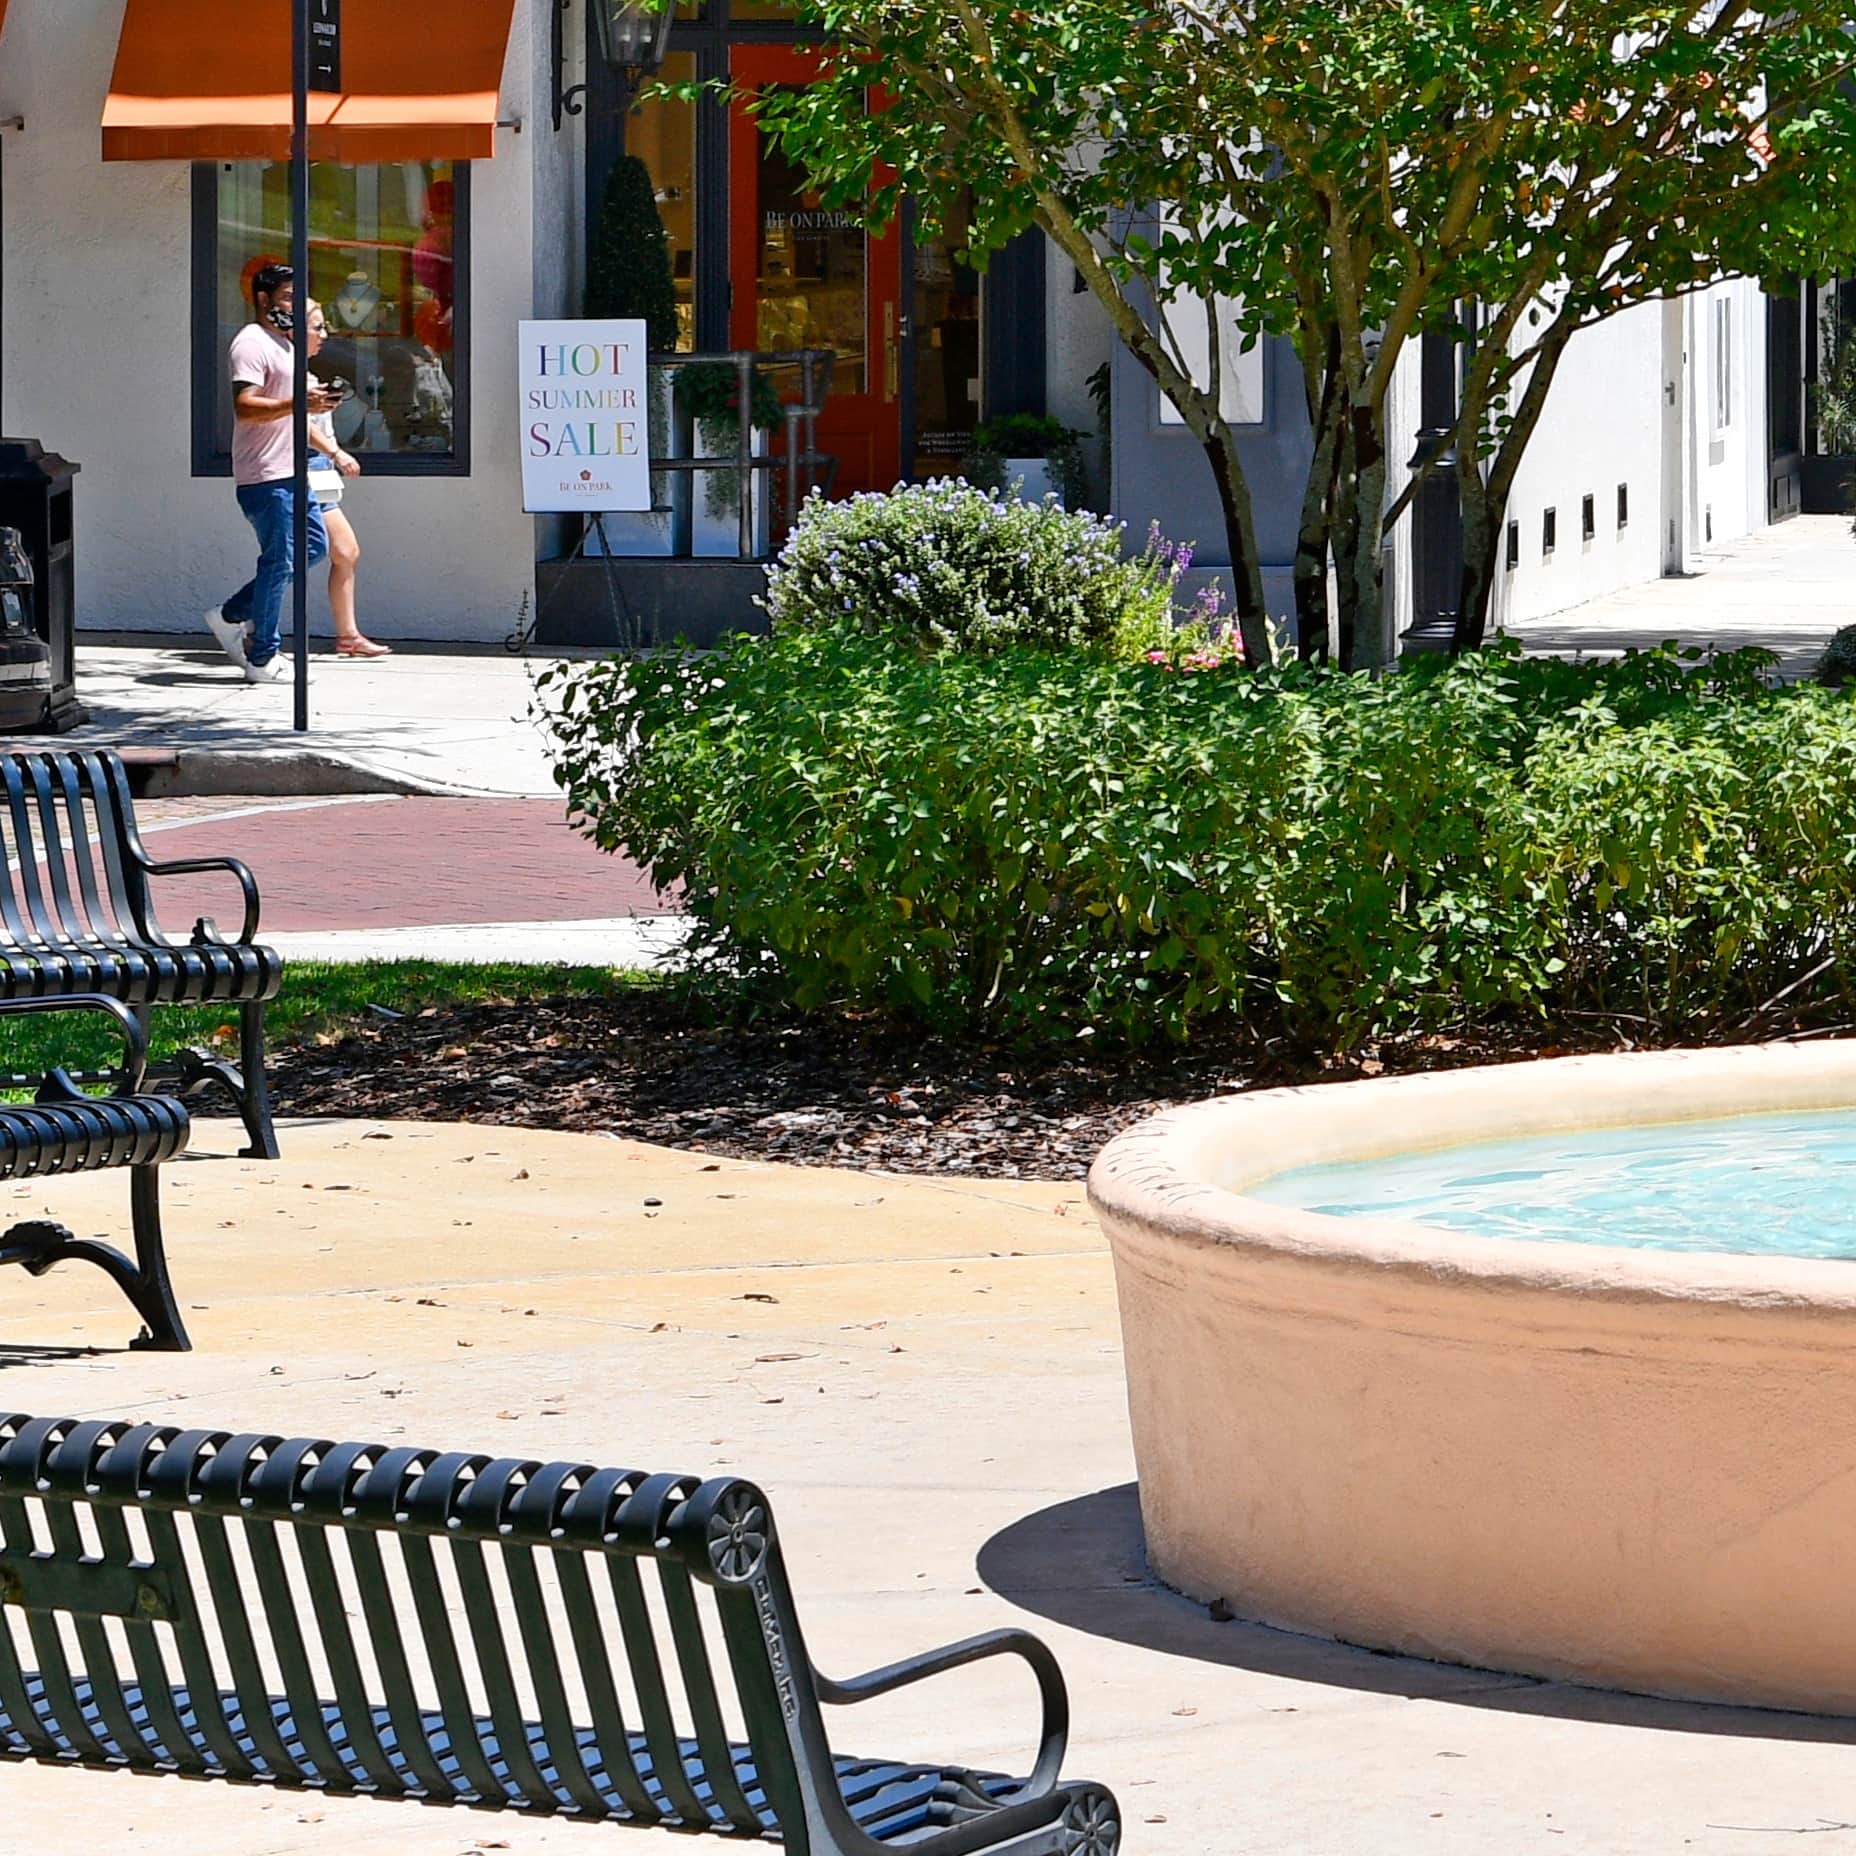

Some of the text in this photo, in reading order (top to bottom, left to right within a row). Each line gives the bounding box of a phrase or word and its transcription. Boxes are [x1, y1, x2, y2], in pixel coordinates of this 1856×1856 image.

[766, 210, 785, 229] BE
[790, 211, 813, 228] ON
[536, 343, 629, 376] HOT
[528, 388, 637, 409] SUMMER
[529, 421, 639, 458] SALE
